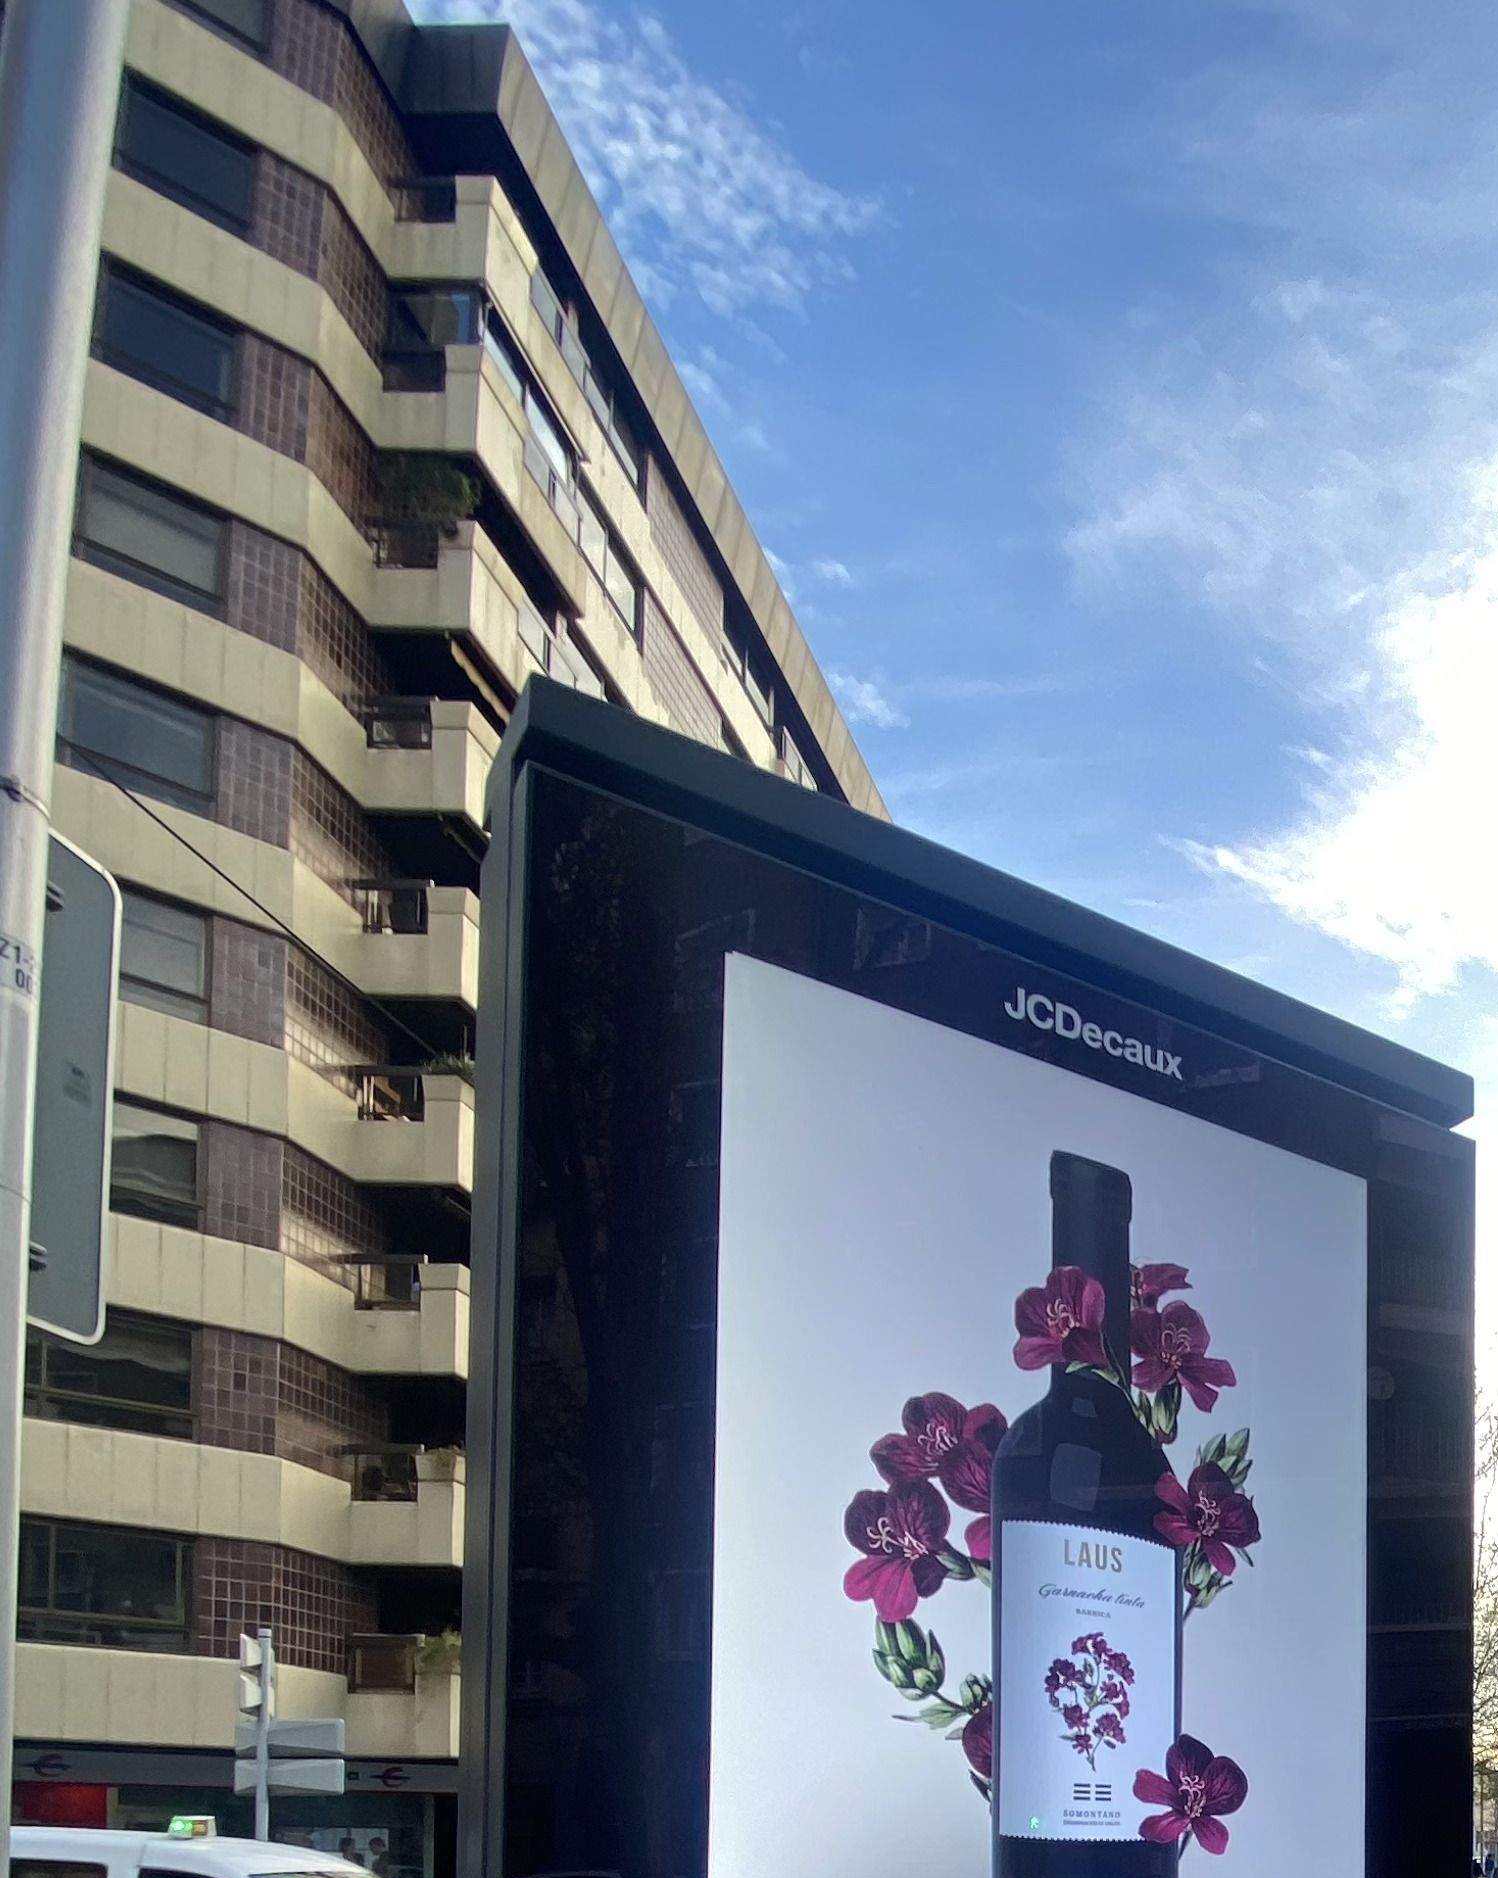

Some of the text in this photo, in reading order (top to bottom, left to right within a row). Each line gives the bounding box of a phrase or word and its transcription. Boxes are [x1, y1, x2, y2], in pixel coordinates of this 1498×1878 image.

[1004, 986, 1183, 1081] JCDecaux
[1063, 1539, 1122, 1573] LAUS
[1038, 1583, 1145, 1609] Garnacha tinta
